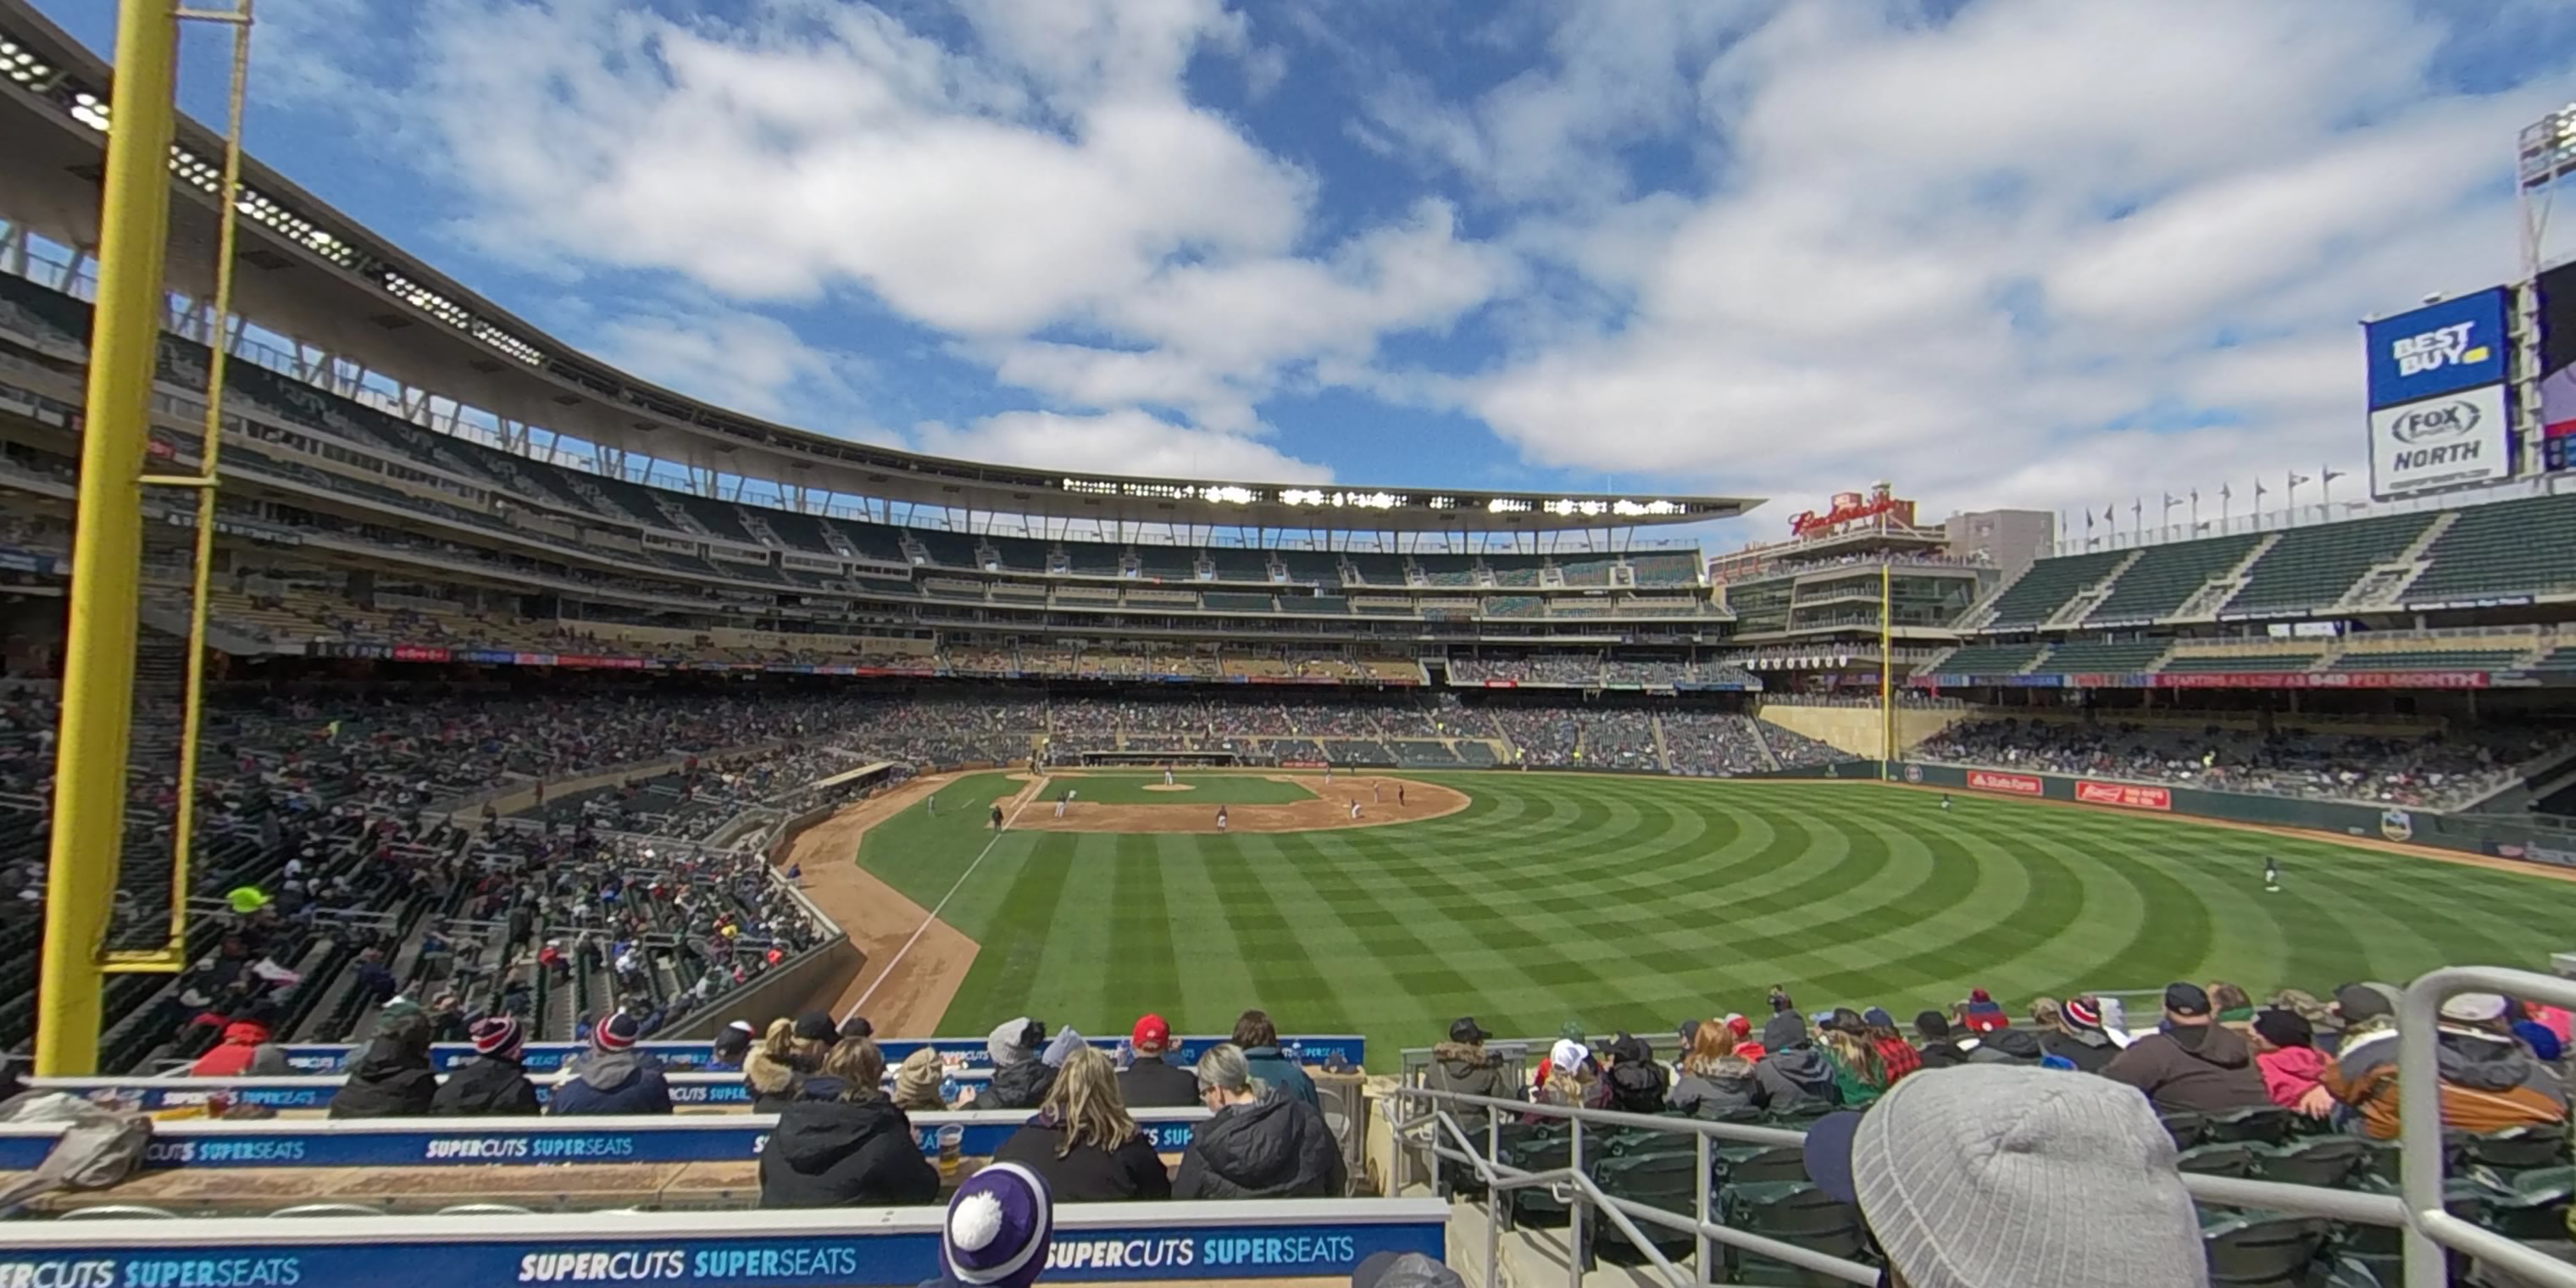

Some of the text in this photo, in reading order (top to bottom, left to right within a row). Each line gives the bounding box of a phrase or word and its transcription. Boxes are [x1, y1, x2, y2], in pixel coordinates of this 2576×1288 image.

[2393, 320, 2474, 359] BEST
[2400, 343, 2468, 376] BUY
[2407, 407, 2459, 430] FOX
[2394, 440, 2481, 472] NORTH
[199, 1141, 306, 1160] SUPERSEATS
[426, 1138, 633, 1158] SUPERCUTS SUPERSEATS
[519, 1247, 856, 1281] SUPERCUTS SUPERSEATS
[1045, 1236, 1354, 1269] SUPERCUTS SUPERSEATS
[125, 1258, 300, 1288] SUPERSEATS
